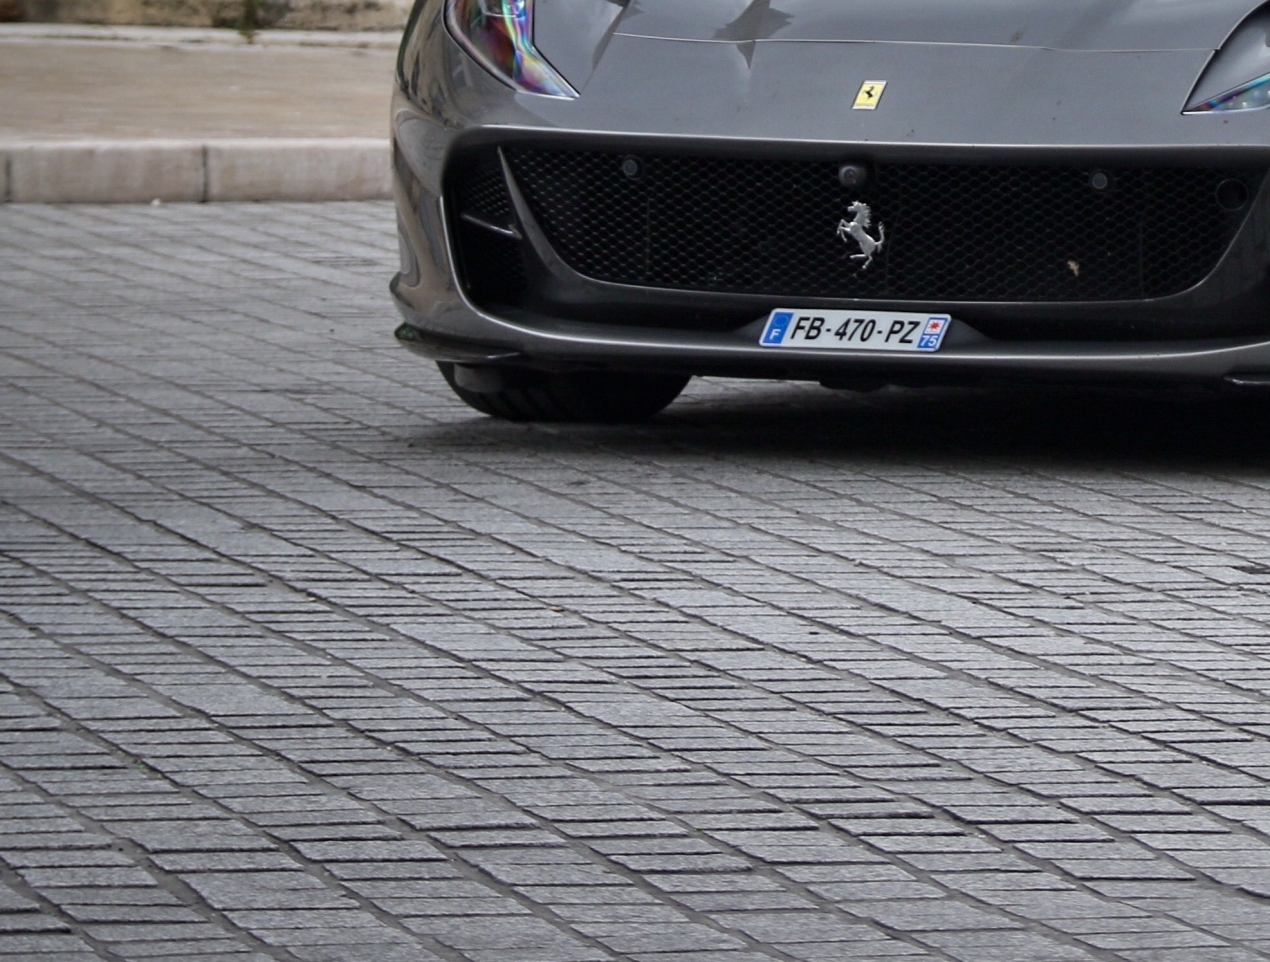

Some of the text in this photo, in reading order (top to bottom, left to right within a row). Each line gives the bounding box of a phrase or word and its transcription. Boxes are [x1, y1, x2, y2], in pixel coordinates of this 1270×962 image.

[769, 329, 782, 340] F
[790, 316, 921, 344] FB-470-PZ
[920, 334, 939, 347] 75
